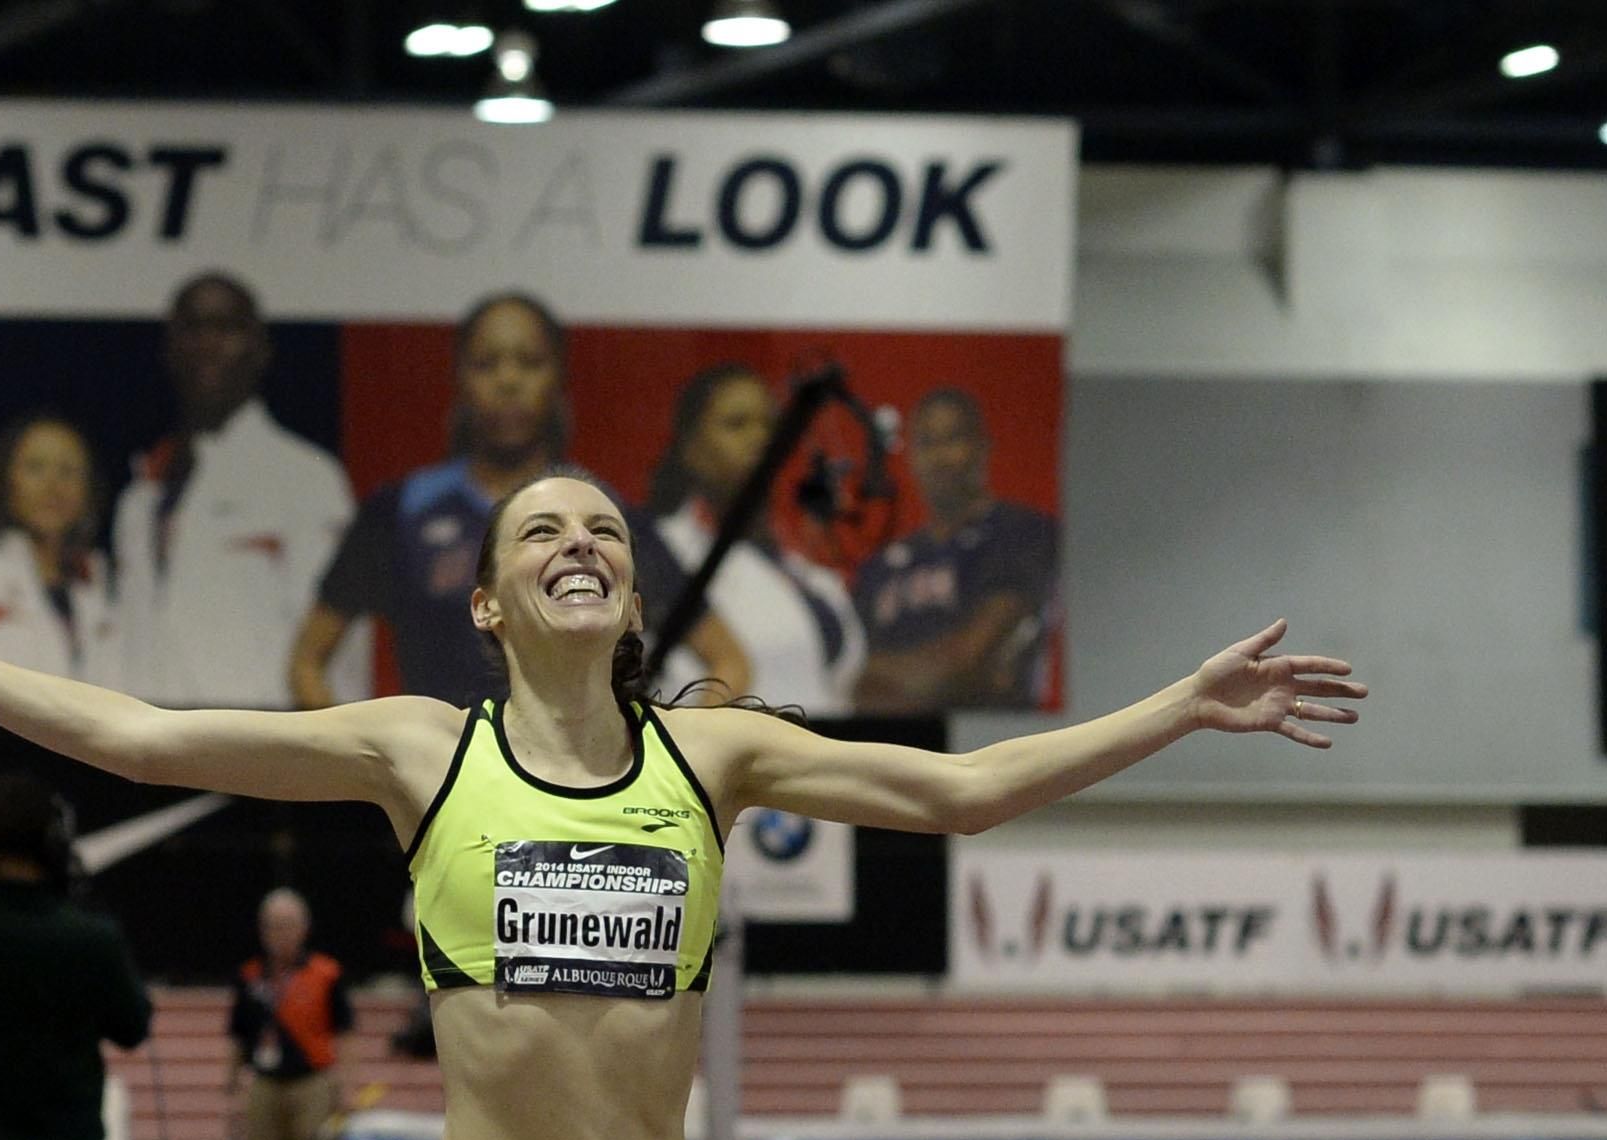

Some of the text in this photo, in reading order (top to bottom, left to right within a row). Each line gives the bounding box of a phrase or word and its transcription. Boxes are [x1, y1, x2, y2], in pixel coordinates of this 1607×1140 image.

[248, 140, 499, 255] HAS
[508, 154, 602, 250] A
[637, 155, 1002, 253] LOOK
[623, 806, 690, 819] BROOKS
[535, 862, 652, 877] 2014 USATF INDOOR
[497, 871, 687, 894] CHAMPIONSHIPS
[497, 898, 682, 951] Grunewald
[1063, 904, 1274, 956] USATF
[552, 968, 649, 990] ALBUQUERQUE
